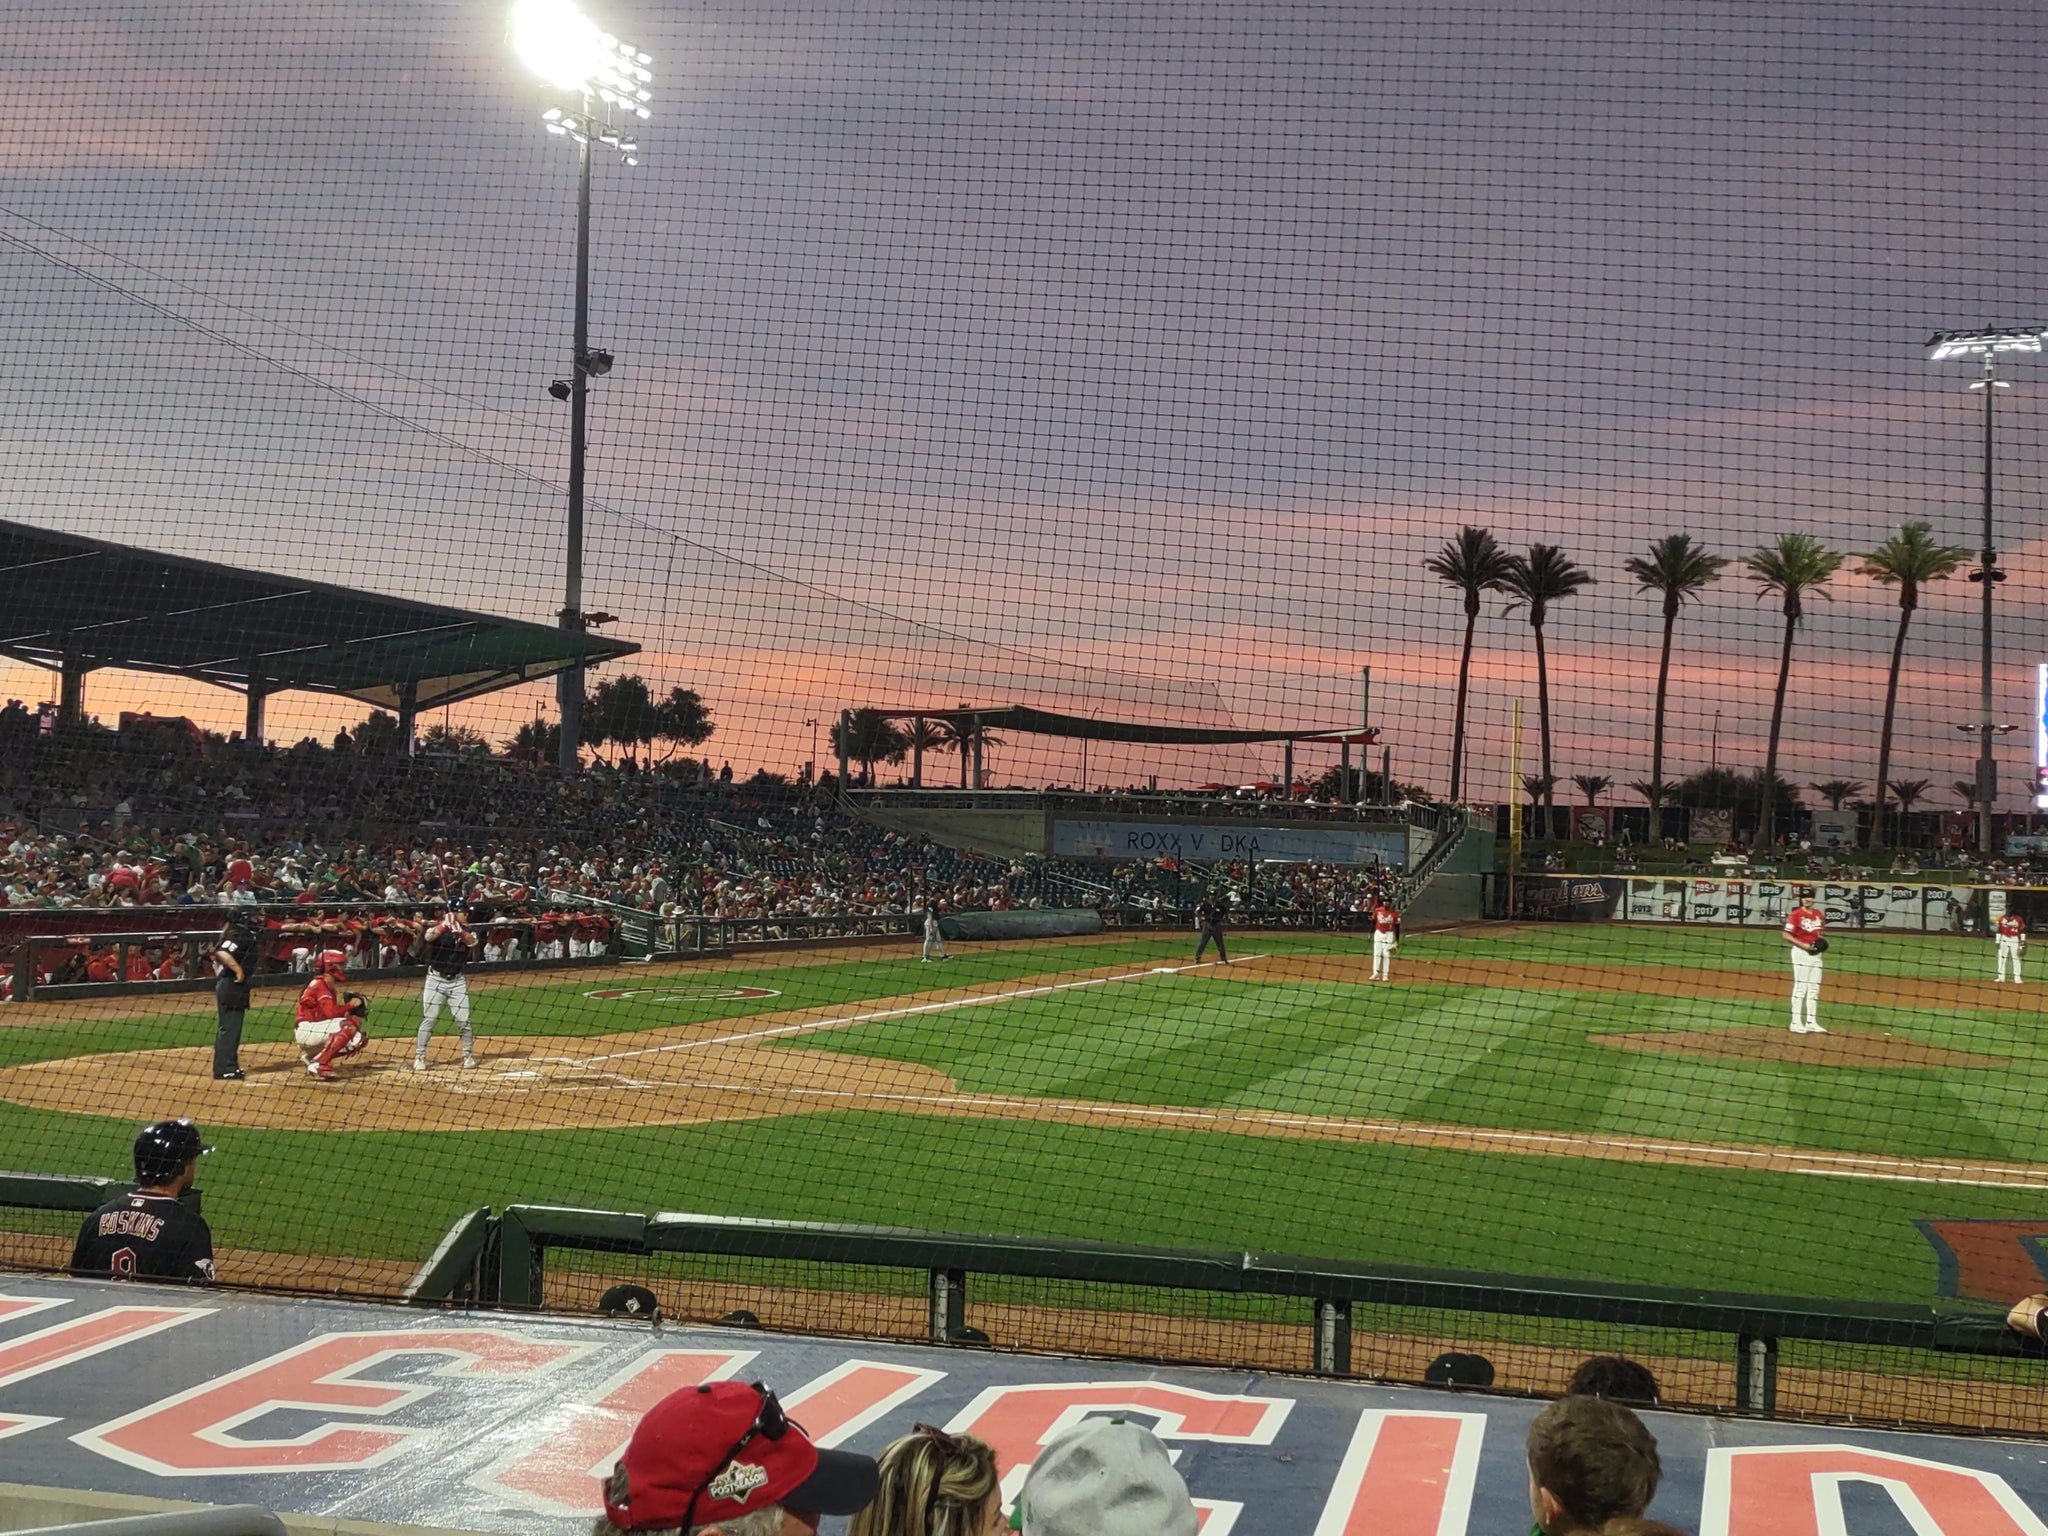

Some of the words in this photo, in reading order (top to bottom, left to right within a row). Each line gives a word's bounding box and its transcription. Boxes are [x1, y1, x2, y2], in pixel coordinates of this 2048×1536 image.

[1127, 831, 1181, 850] ROXX
[1695, 906, 1714, 915] 2017
[98, 1210, 165, 1242] HOSKINS
